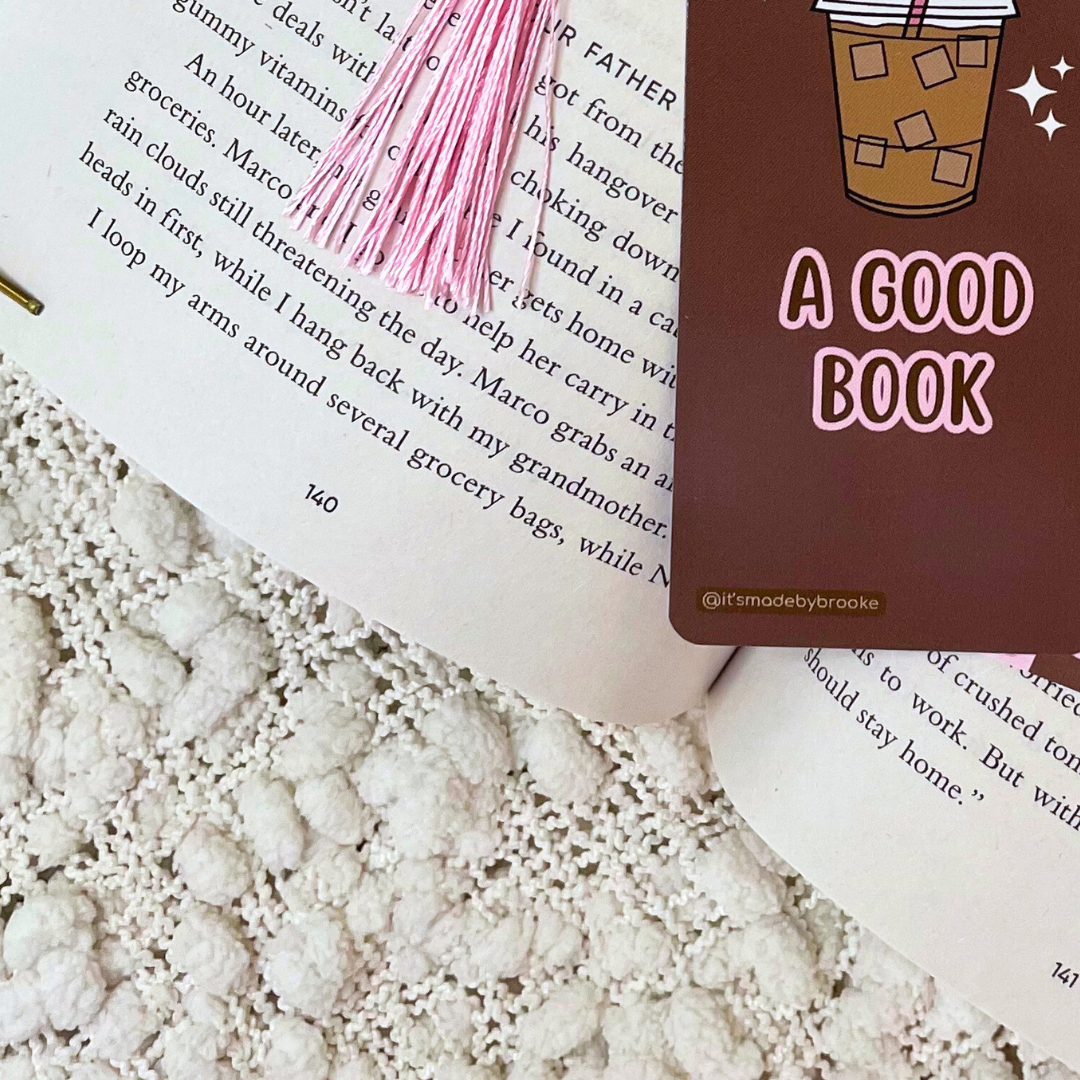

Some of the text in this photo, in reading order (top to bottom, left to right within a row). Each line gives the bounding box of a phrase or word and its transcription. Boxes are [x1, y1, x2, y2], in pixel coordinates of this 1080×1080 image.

[259, 48, 349, 123] vitamins
[582, 40, 678, 112] FATHER
[77, 139, 134, 197] heads
[133, 185, 158, 218] in
[157, 206, 204, 259] first,
[213, 249, 272, 302] while
[273, 290, 293, 315] I
[287, 301, 349, 361] hang
[348, 342, 406, 395] back
[410, 386, 464, 432] with
[466, 424, 511, 460] my
[102, 107, 651, 481] rain clouds still threatening the day. Marco grabs an
[778, 246, 1034, 336] A GOOD
[86, 205, 644, 577] I loop my arms around several grocery bags, while
[812, 346, 995, 434] BOOK
[303, 482, 339, 514] 140
[879, 665, 902, 692] to
[911, 691, 968, 751] work.
[977, 742, 1025, 789] But
[953, 671, 1045, 743] crushed
[854, 708, 985, 806] stay home.”
[1050, 960, 1080, 989] 141
